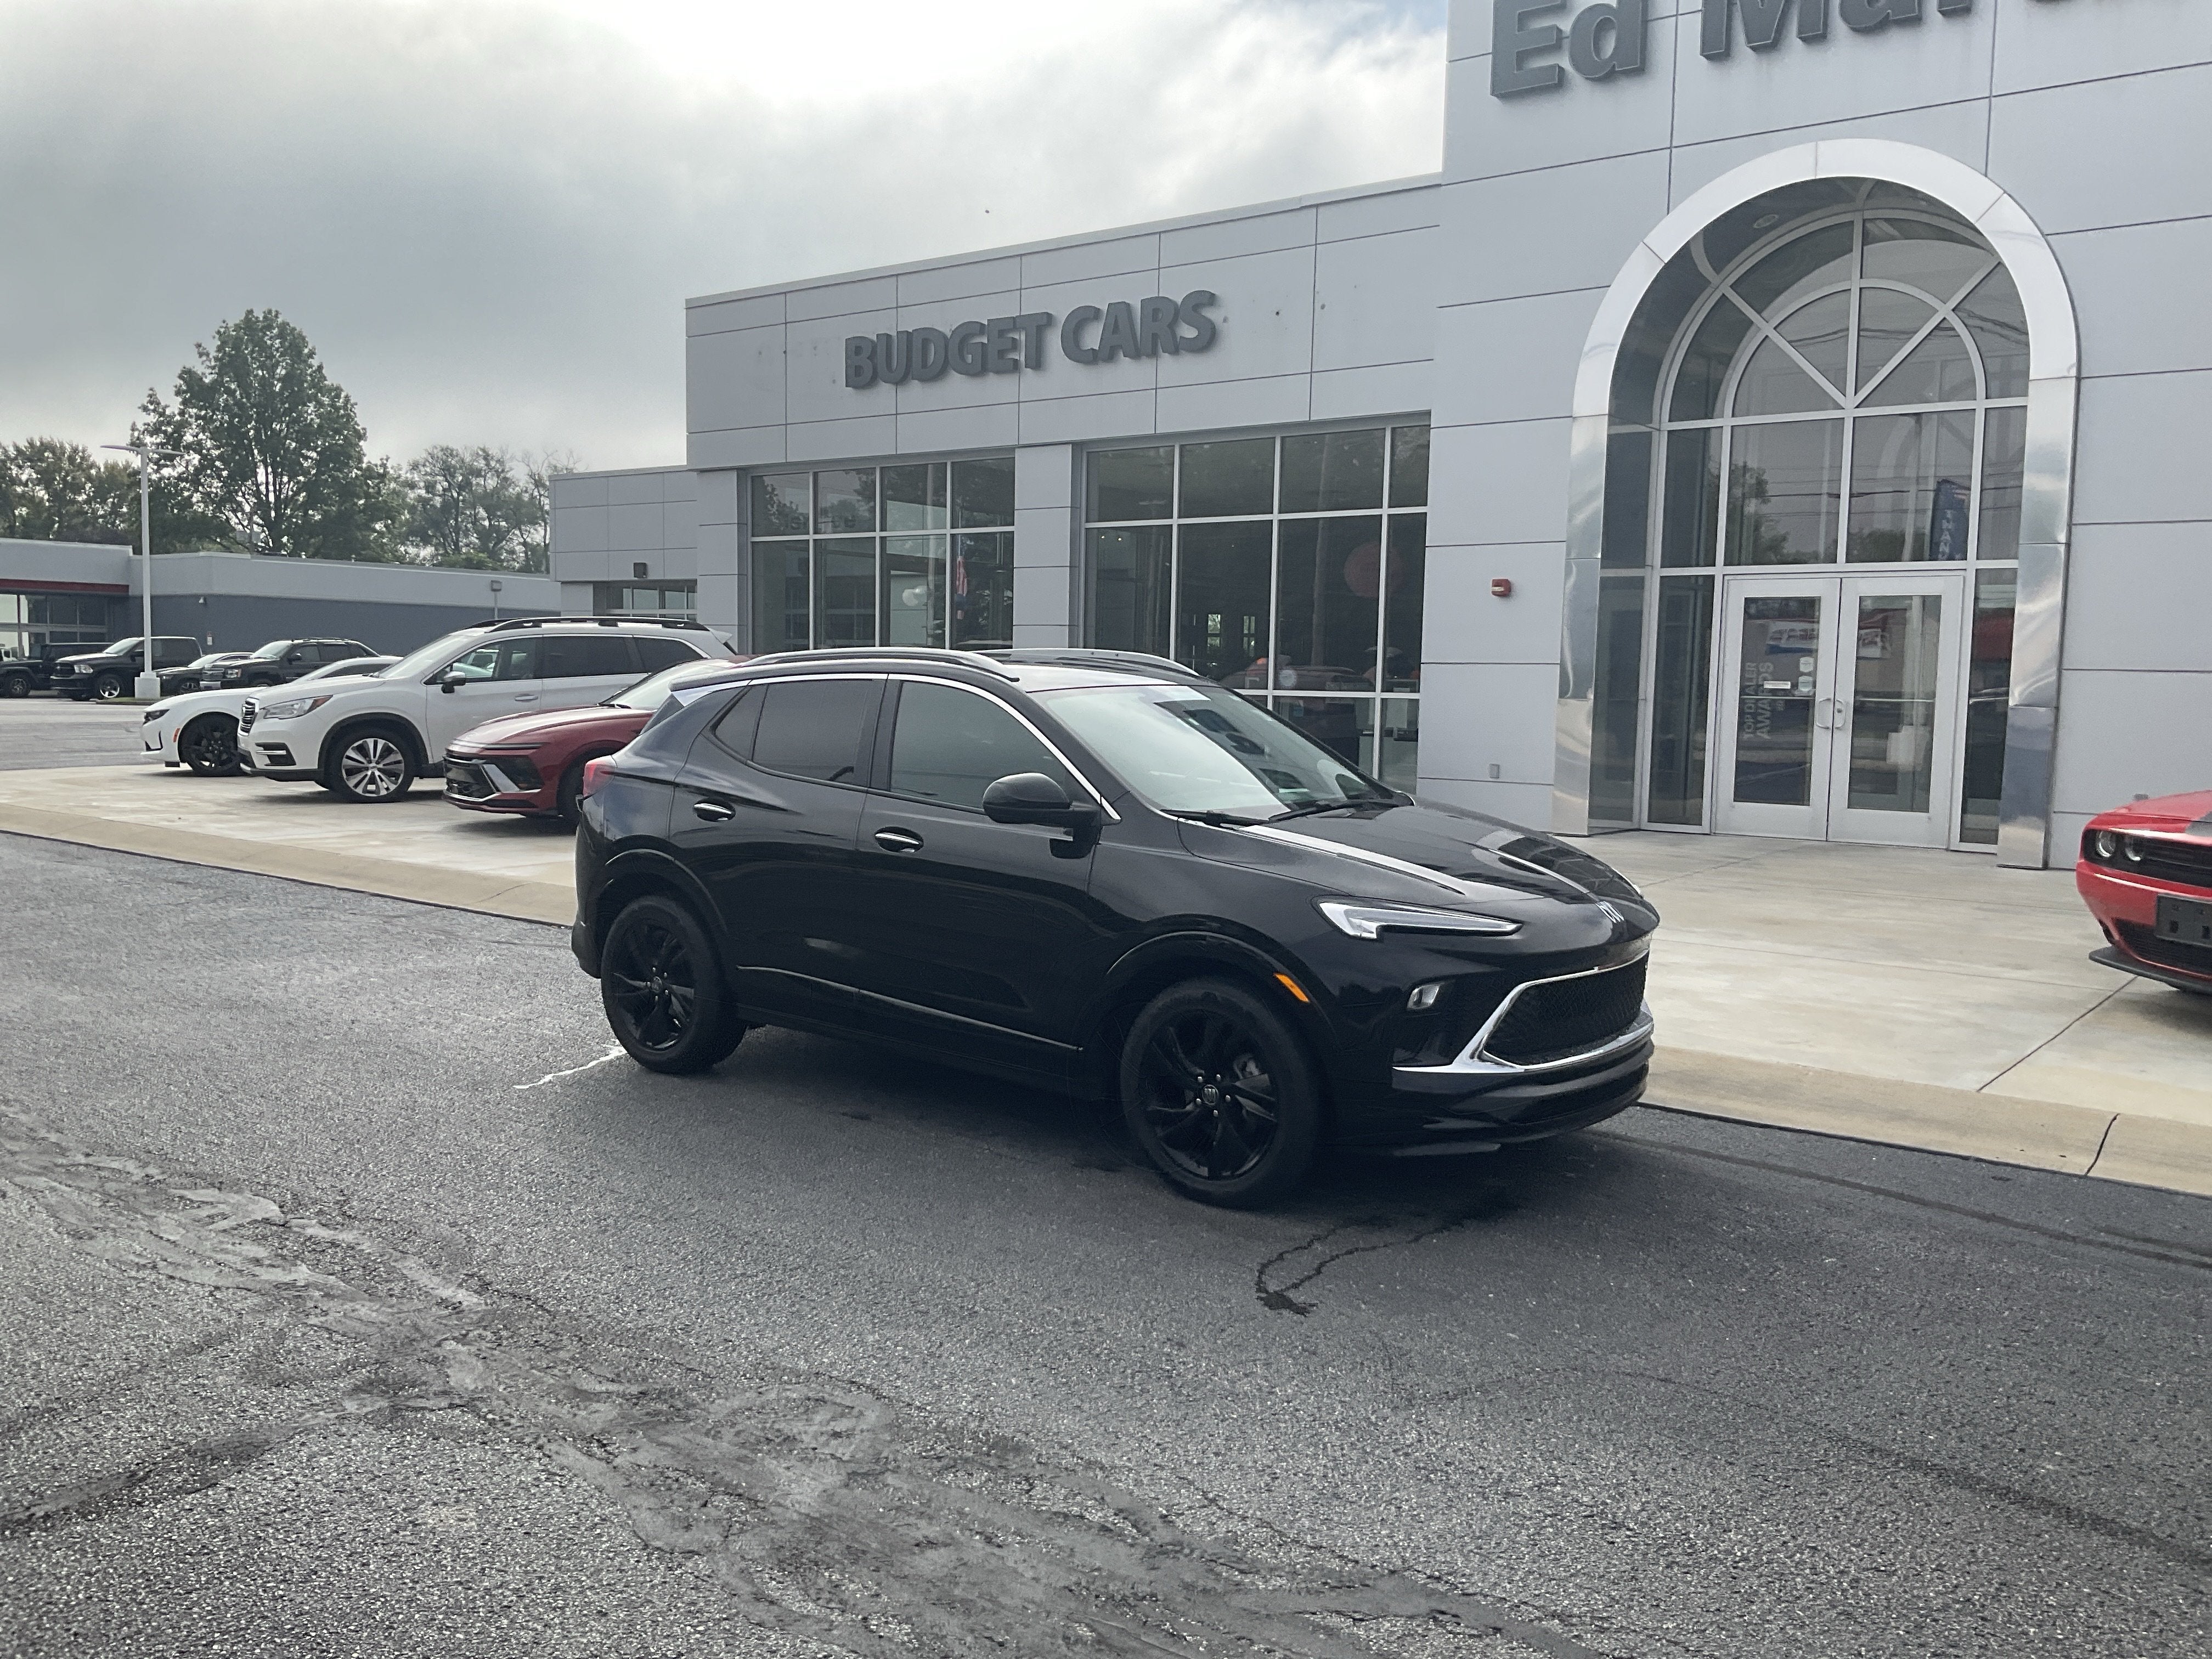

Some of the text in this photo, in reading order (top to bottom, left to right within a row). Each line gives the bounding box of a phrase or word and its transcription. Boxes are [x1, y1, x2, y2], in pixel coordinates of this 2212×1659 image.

[1490, 0, 1645, 96] Ed
[845, 290, 1216, 388] BUDGET CARS
